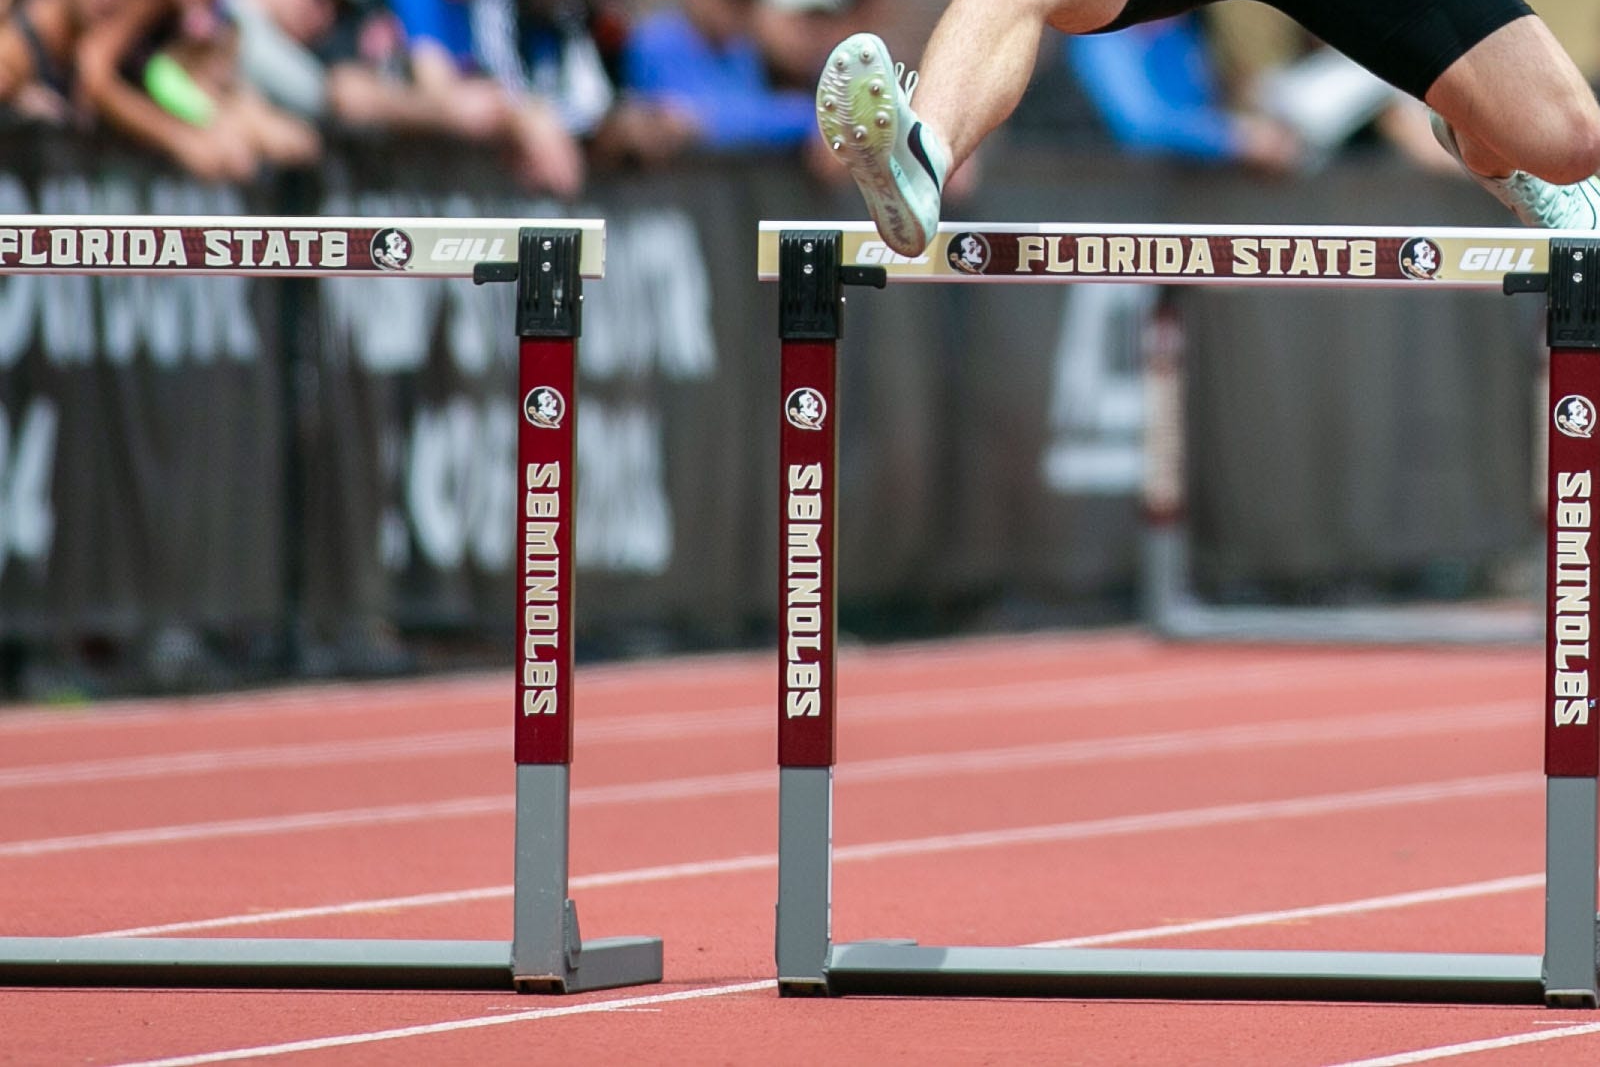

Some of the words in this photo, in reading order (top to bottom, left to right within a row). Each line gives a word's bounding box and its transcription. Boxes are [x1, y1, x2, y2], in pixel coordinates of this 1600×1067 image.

[0, 228, 187, 265] FLORIDA
[203, 230, 348, 267] STATE
[430, 238, 505, 261] GILL
[1016, 235, 1214, 276] FLORIDA
[1229, 237, 1377, 277] STATE
[1459, 247, 1535, 271] GILL
[524, 460, 560, 717] SEMINOLES
[786, 462, 823, 719] SEMINOLES
[1554, 470, 1592, 728] SEMINOLES
